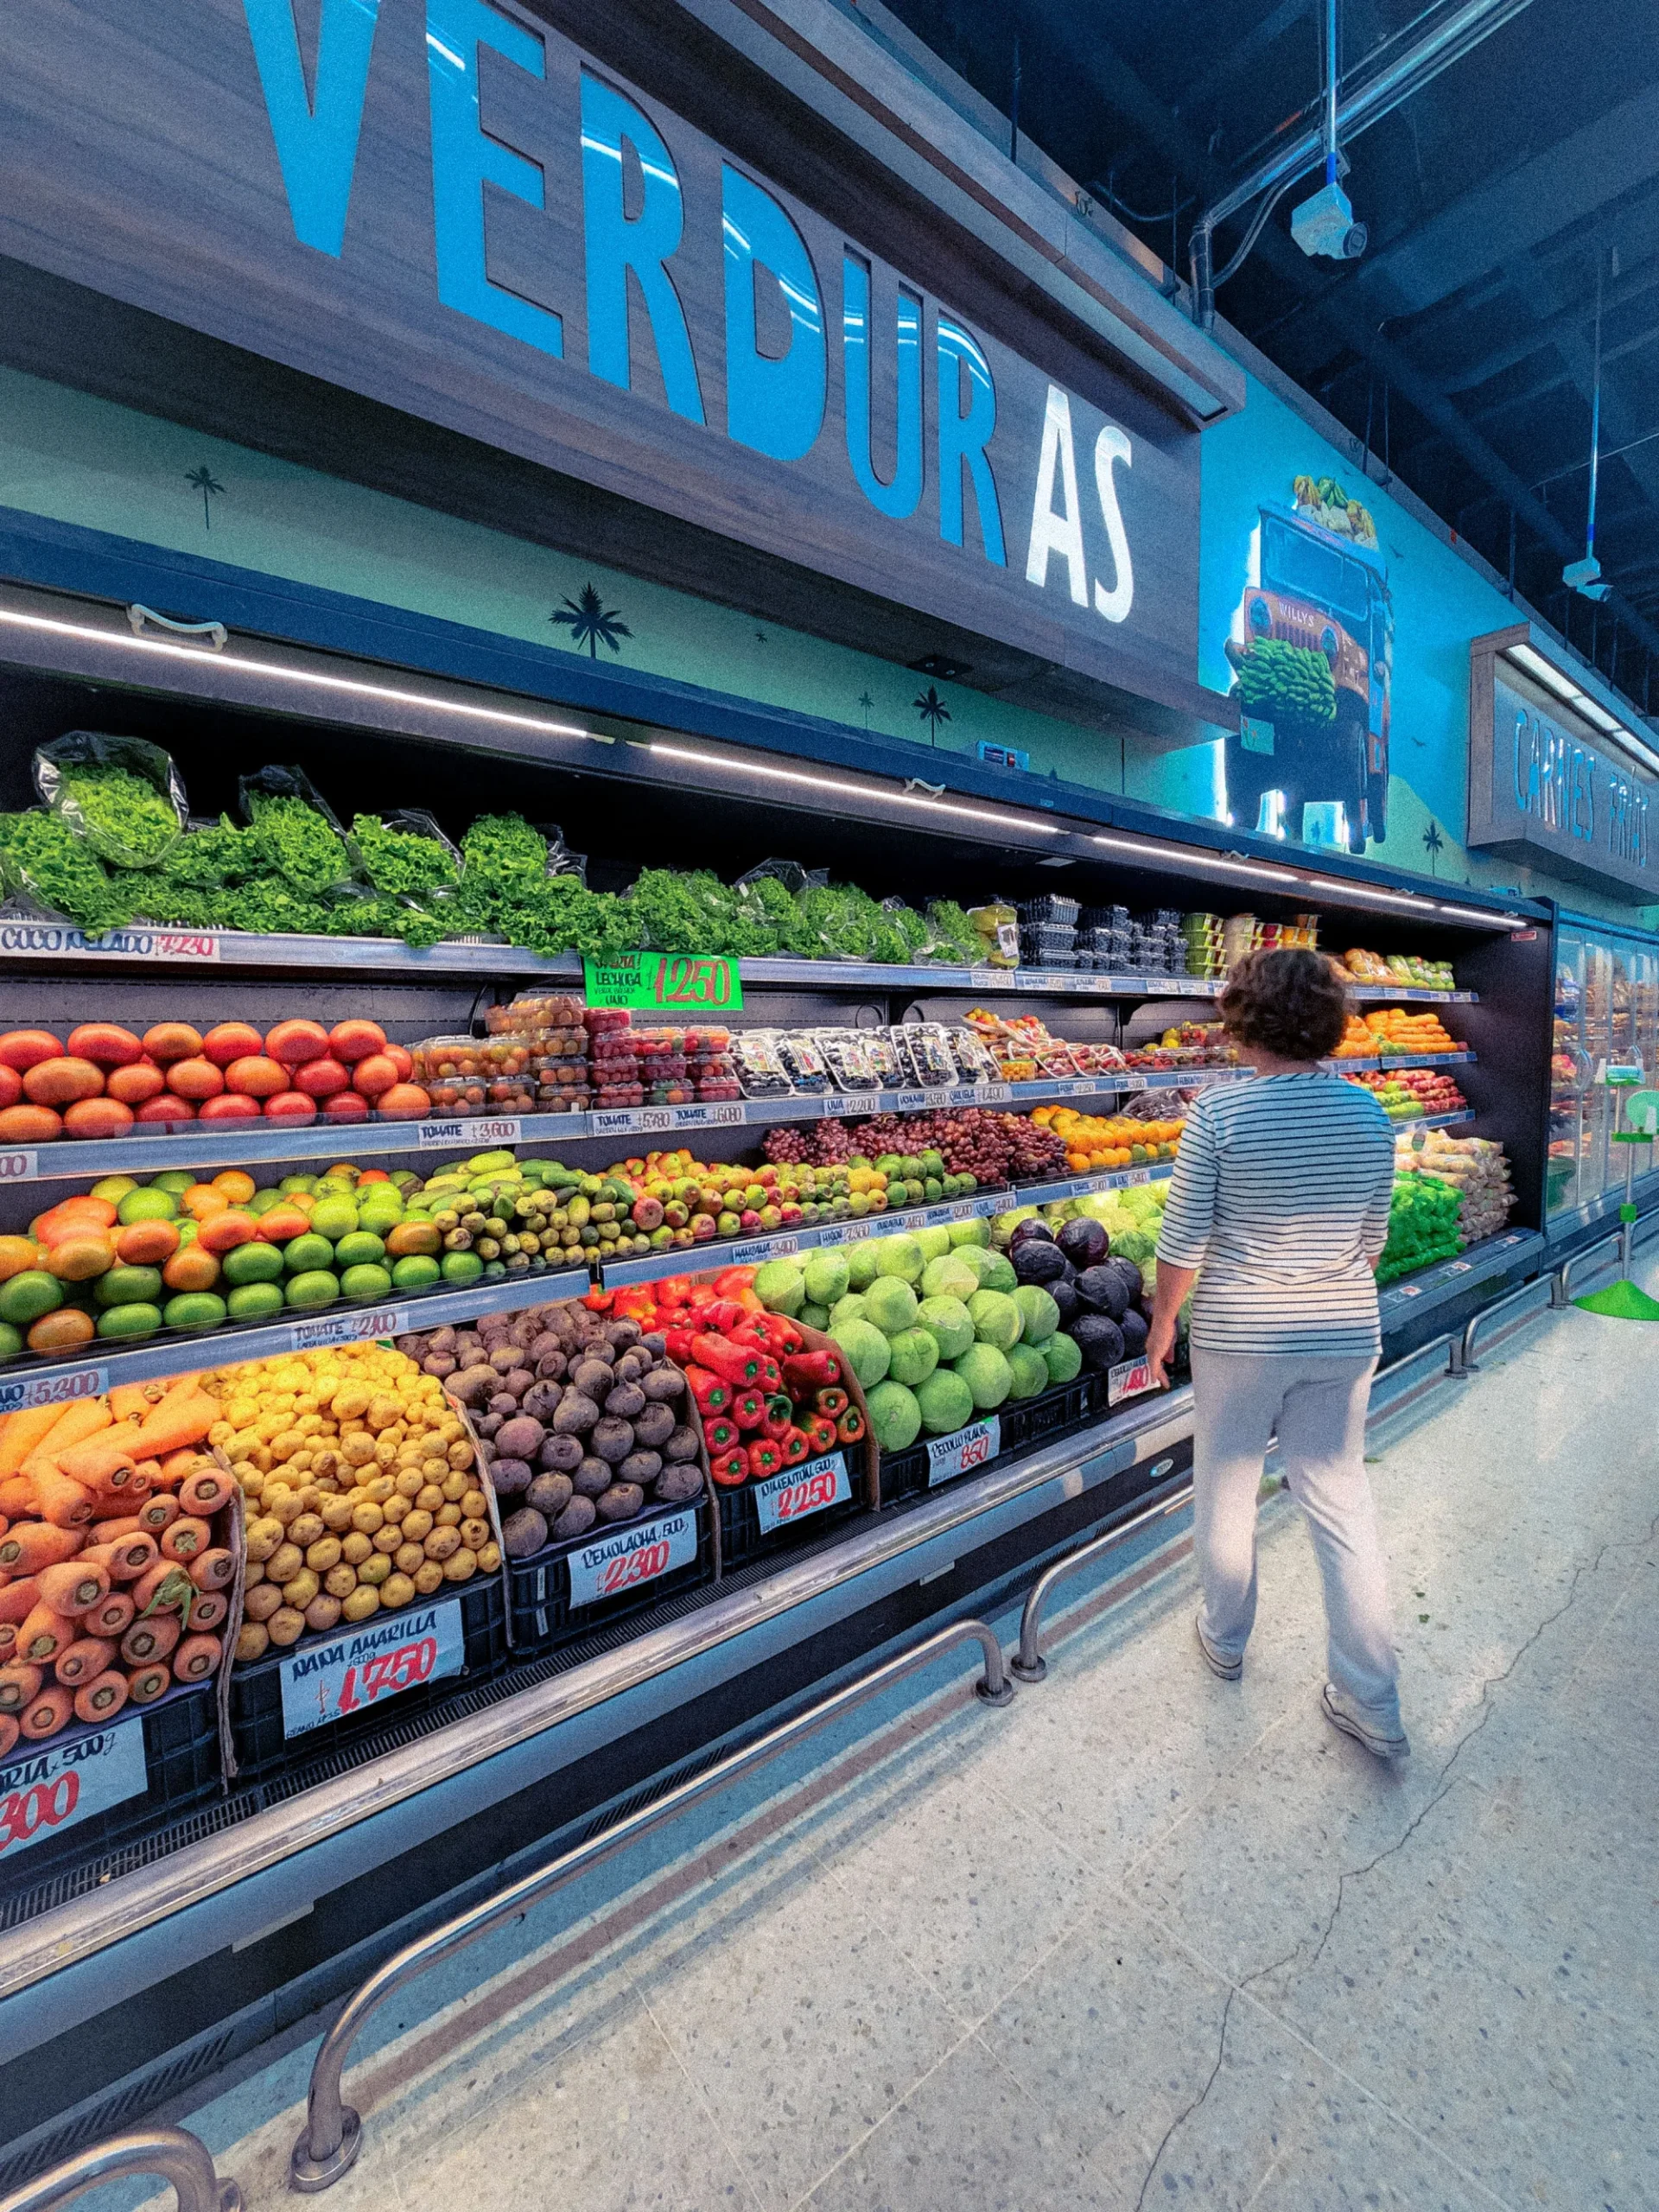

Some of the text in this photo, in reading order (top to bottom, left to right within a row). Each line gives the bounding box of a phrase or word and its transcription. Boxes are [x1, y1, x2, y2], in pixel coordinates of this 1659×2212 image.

[245, 0, 1135, 624] VERDURAS
[1278, 601, 1315, 628] WILLYS
[1514, 709, 1596, 842] CARNES
[1, 926, 61, 951] COCO
[66, 931, 153, 954] PLADO
[595, 971, 643, 988] LECHUGA
[595, 1113, 632, 1127] TOMATE
[675, 1109, 707, 1121] TOMATE
[420, 1123, 463, 1139] TOMATE
[294, 1319, 345, 1341] TOMATE
[581, 1524, 660, 1570] REMOLACHA
[291, 1610, 437, 1683] PAPA AMARILLA
